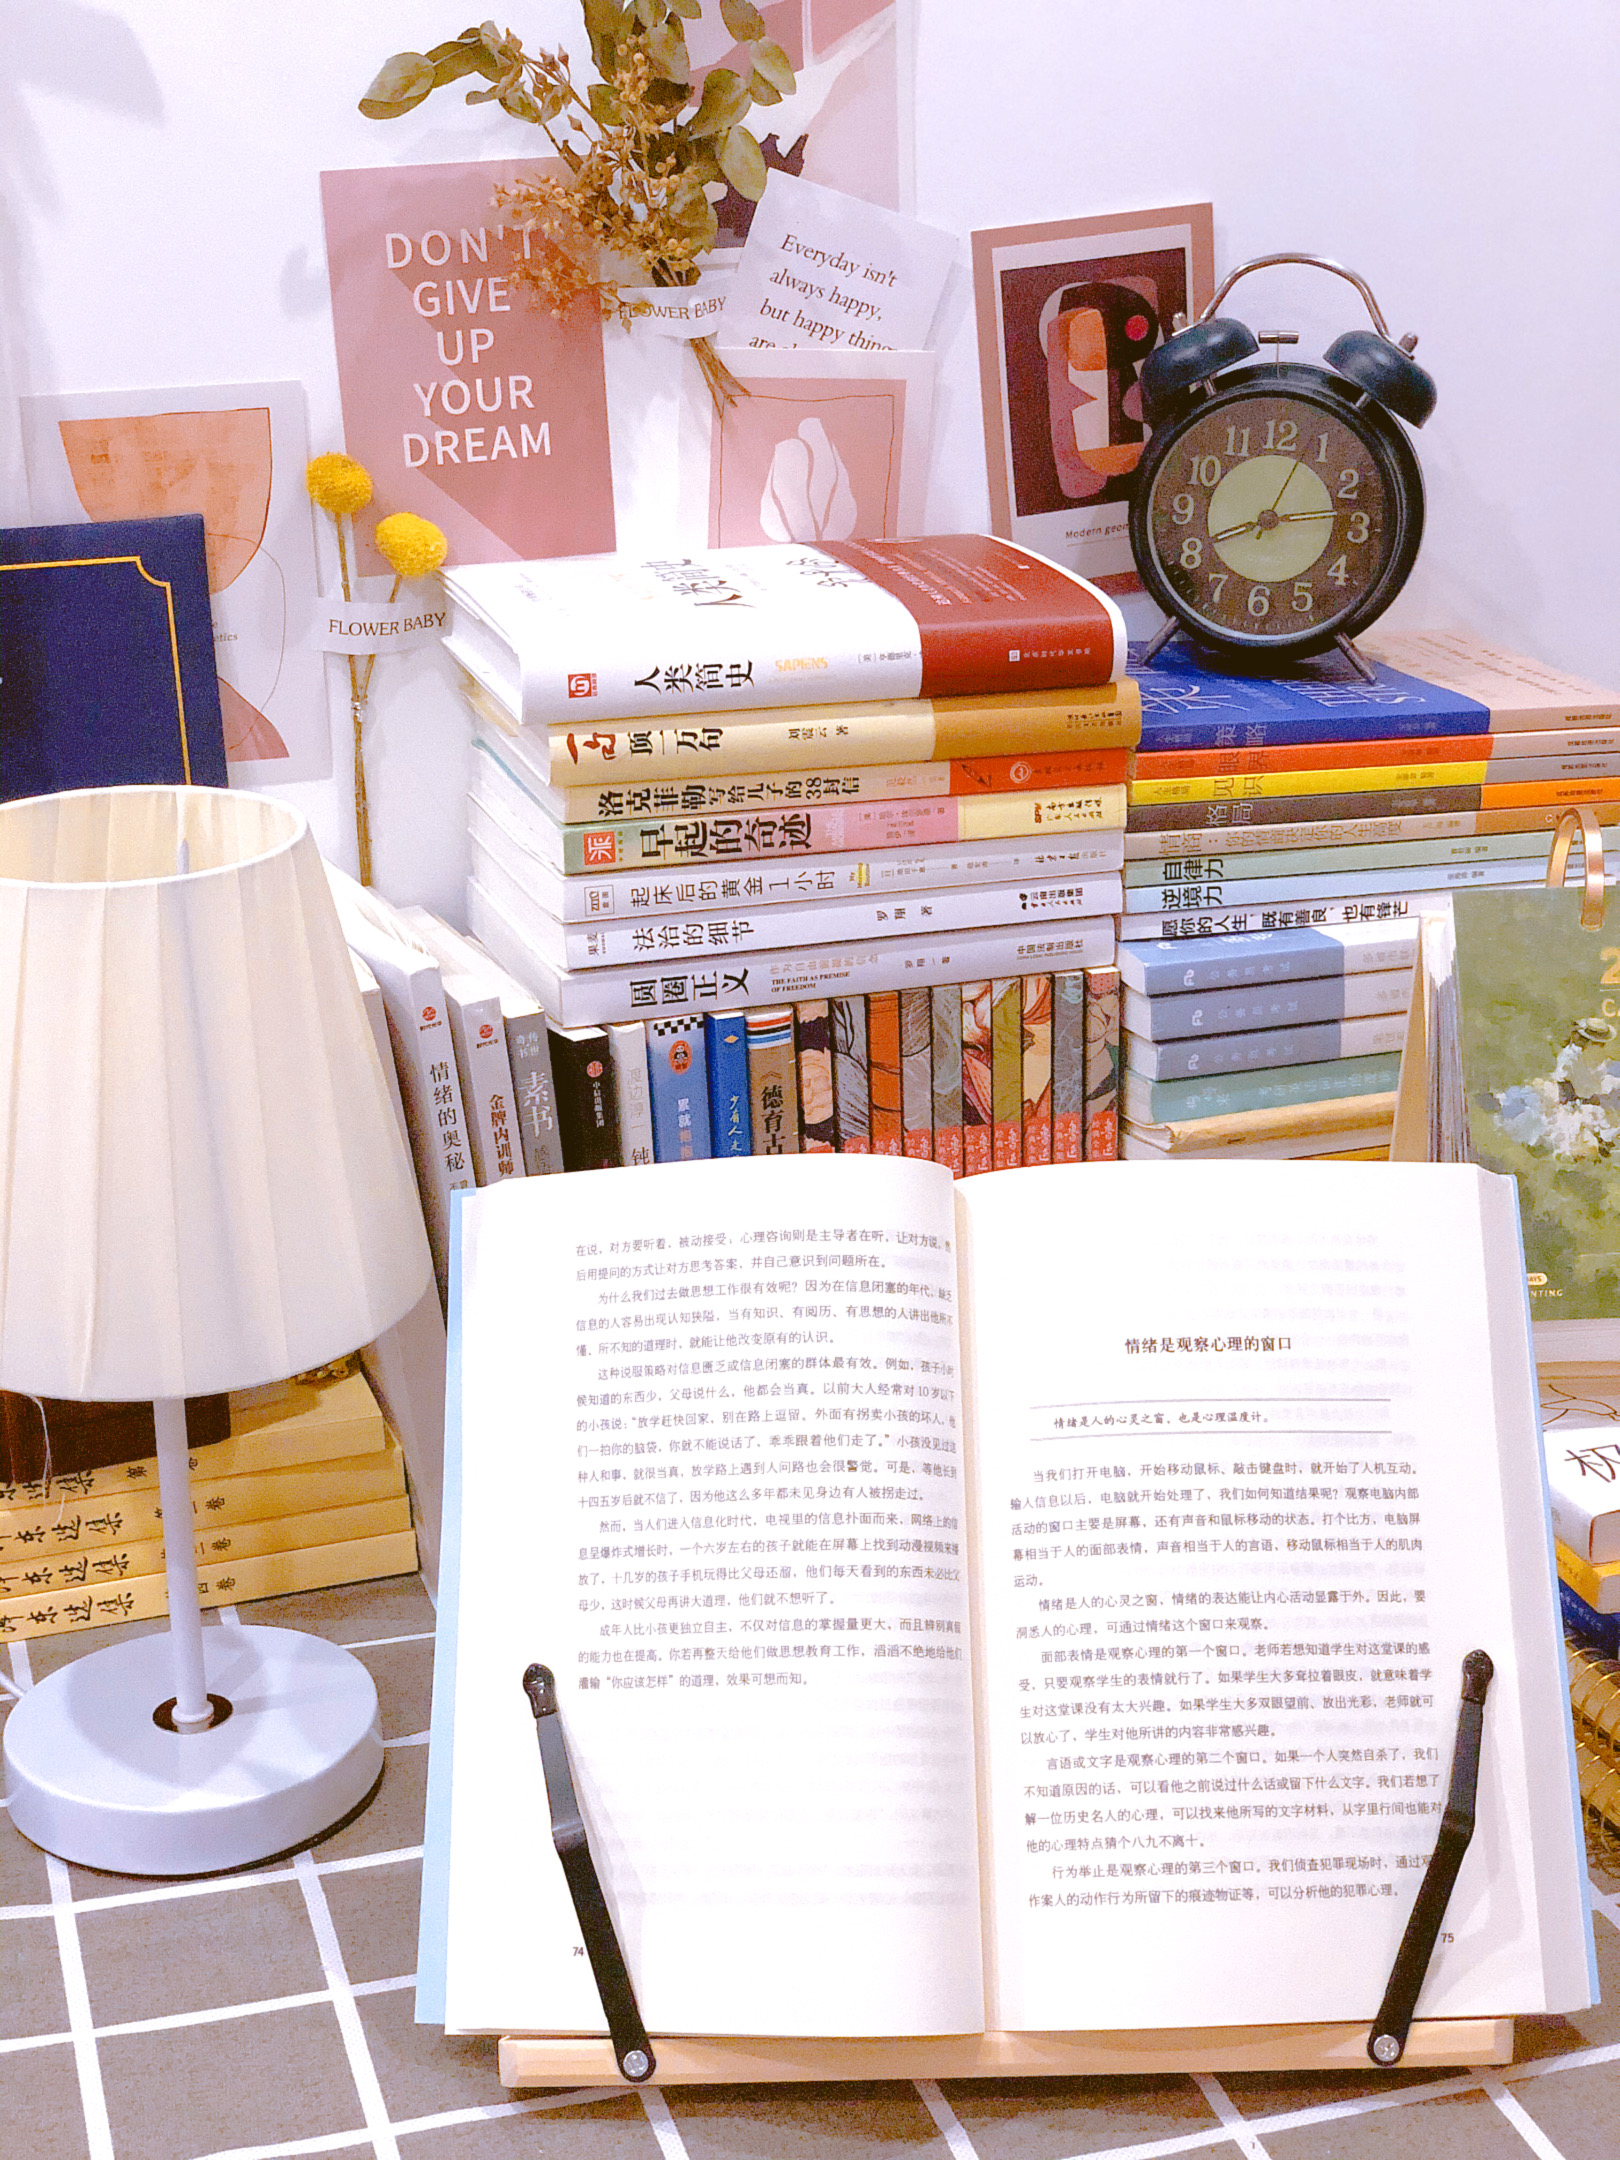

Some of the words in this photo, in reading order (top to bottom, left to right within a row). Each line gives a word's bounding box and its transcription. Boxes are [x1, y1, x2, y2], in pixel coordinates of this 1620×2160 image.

[385, 225, 535, 270] DON'T
[781, 234, 861, 278] Everyday
[862, 263, 898, 288] isn't
[412, 277, 511, 317] GIVE
[619, 303, 690, 320] FLOWER
[695, 295, 726, 319] BABY
[769, 268, 825, 299] always
[828, 286, 882, 321] happy,
[760, 298, 790, 322] but
[793, 310, 846, 344] happy
[437, 328, 495, 368] UP
[413, 374, 535, 418] YOUR
[403, 422, 552, 468] DREAM
[1224, 425, 1251, 457] 11
[1262, 419, 1298, 451] 12
[1316, 432, 1329, 463] 1
[1187, 455, 1222, 487] 10
[1337, 468, 1360, 499] 2
[1171, 494, 1195, 525] 9
[1065, 527, 1102, 539] Modern
[1346, 512, 1370, 544] 3
[1180, 538, 1202, 570] 8
[1327, 555, 1349, 587] 4
[1208, 573, 1228, 603] 7
[1248, 585, 1271, 617] 6
[1292, 582, 1314, 612] 5
[329, 618, 400, 637] FLOWER
[403, 611, 446, 632] BABY
[634, 659, 755, 696] 人类简史
[1214, 722, 1268, 748] 策略
[598, 776, 860, 818] 洛克菲勒写给儿子的38封信
[1213, 775, 1264, 797] 见识
[1206, 803, 1254, 827] 格局
[640, 812, 812, 860] 早起的奇迹
[1162, 857, 1224, 881] 自律力
[631, 870, 835, 908] 起床后的黄金1小时
[1162, 885, 1223, 909] 逆境力
[632, 920, 755, 952] 法治的细节
[1017, 939, 1084, 955] 中国法制出版社
[630, 968, 751, 1008] 圆圈正义
[771, 977, 786, 986] THE
[786, 975, 805, 985] FAITH
[808, 974, 818, 983] AS
[819, 970, 851, 981] PREMISE
[782, 982, 817, 993] FREEDOM
[429, 1061, 466, 1173] 情绪的奥秘
[521, 1071, 554, 1137] 素书
[489, 1094, 515, 1177] 金牌内训师
[1005, 1128, 1018, 1167] 鲁迅
[1038, 1121, 1050, 1162] 鲁迅
[1066, 1120, 1079, 1159] 鲁迅
[1103, 1118, 1117, 1157] 鲁迅
[1124, 1336, 1292, 1355] 情绪是观察心理的窗口
[1053, 1411, 1269, 1430] 情绪是人的心灵之窗，也是心理温度计。
[1014, 1573, 1044, 1589] 运动。
[1026, 1833, 1205, 1853] 他的心理特点猜个八九不离十。
[573, 1946, 584, 1956] 74
[1440, 1932, 1454, 1944] 75
